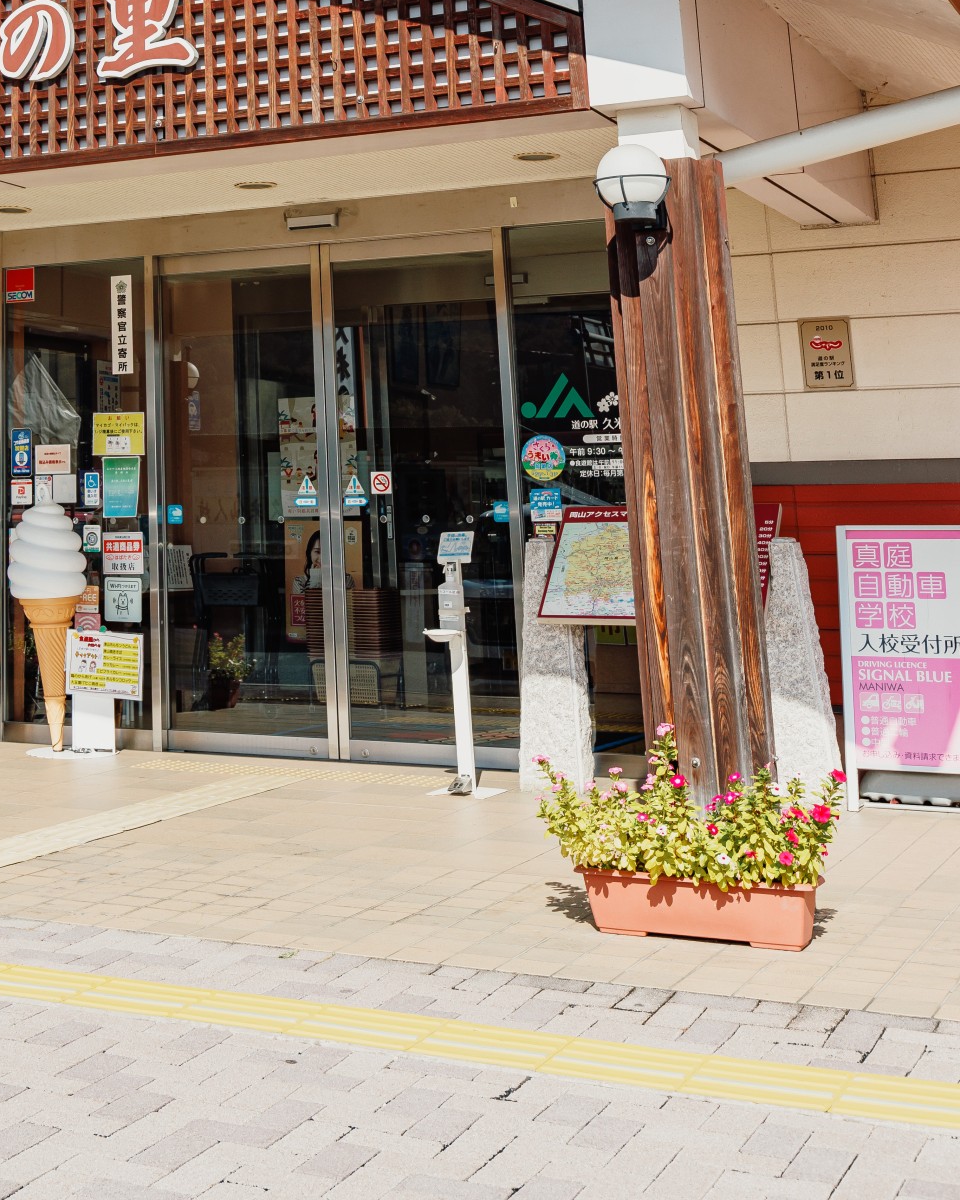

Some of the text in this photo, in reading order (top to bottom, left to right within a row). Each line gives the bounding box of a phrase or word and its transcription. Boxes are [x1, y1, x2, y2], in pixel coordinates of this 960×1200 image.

[8, 291, 33, 300] SECOM
[117, 294, 128, 372] 警察官立寄所
[571, 419, 598, 429] 道の駅
[570, 447, 585, 456] 午前
[587, 447, 606, 455] 9:30
[855, 544, 911, 567] 真庭
[858, 574, 945, 598] 自動車
[80, 593, 97, 602] REE
[858, 603, 915, 628] 学校
[857, 660, 928, 669] DRIVING LICENCE
[858, 669, 953, 683] SIGNAL BLUE
[859, 682, 905, 692] MANIWA
